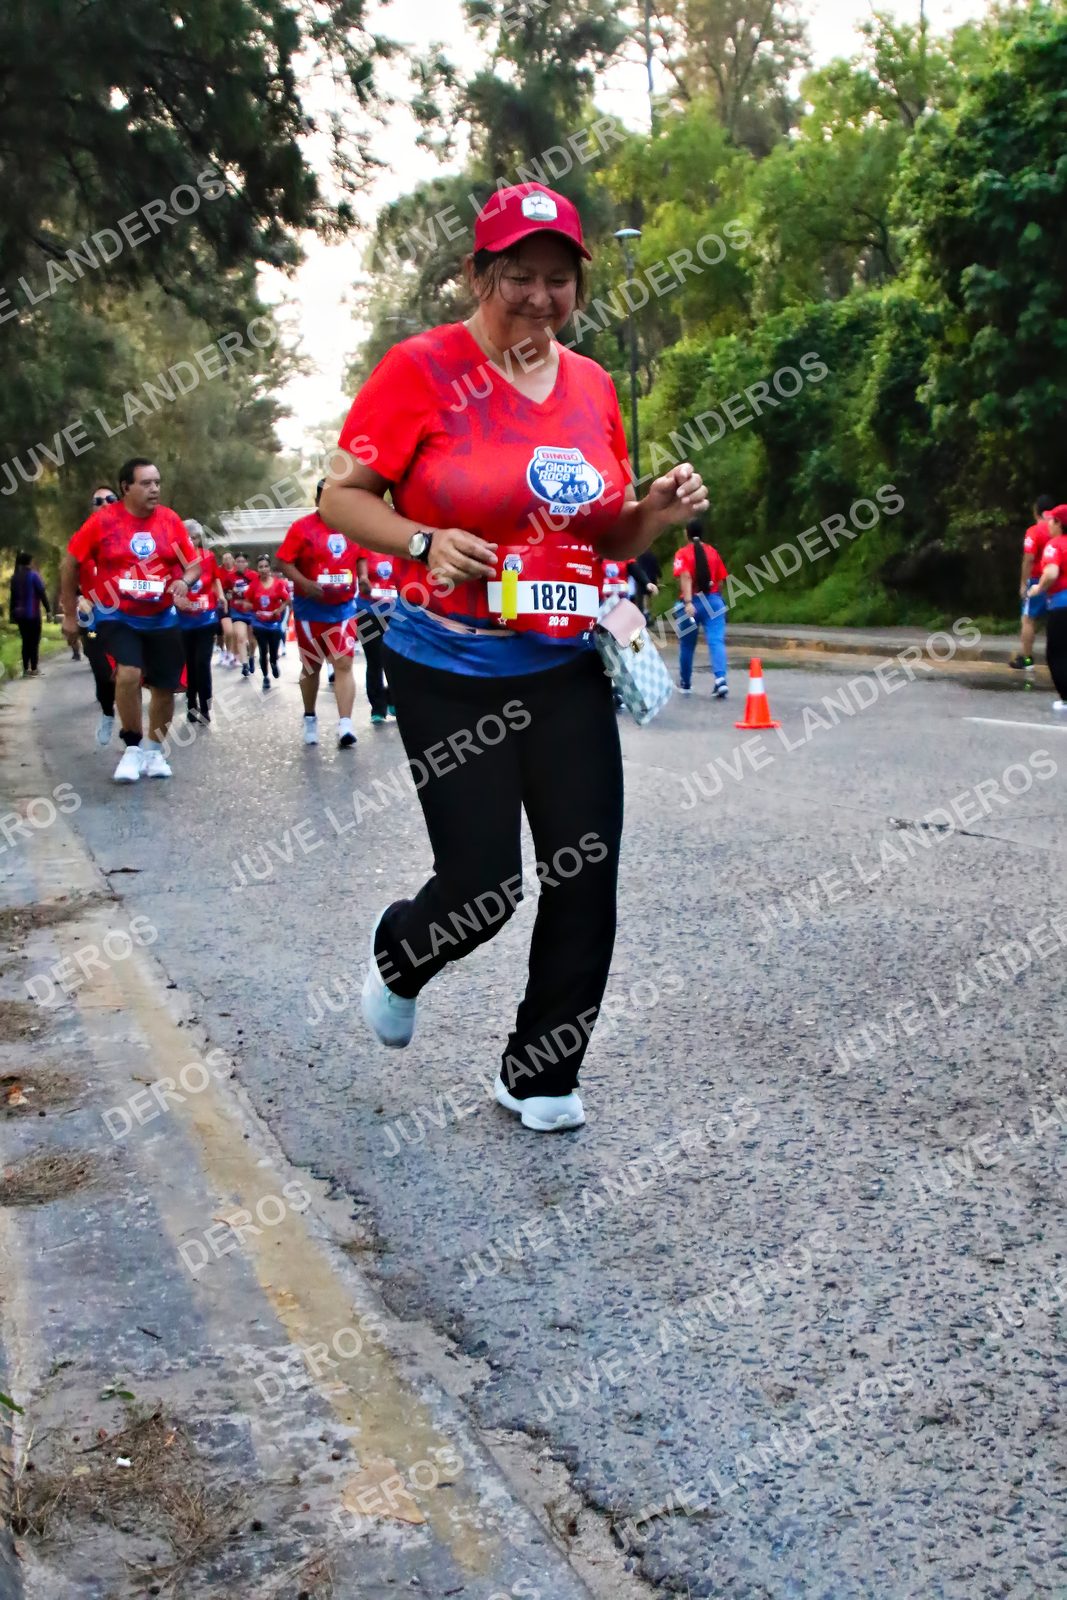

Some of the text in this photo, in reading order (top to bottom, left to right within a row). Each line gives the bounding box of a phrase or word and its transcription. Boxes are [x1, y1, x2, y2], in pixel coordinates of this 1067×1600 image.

[541, 452, 578, 461] BIMBO
[545, 462, 583, 475] Global
[538, 470, 570, 482] Race
[552, 505, 577, 515] 2026
[132, 580, 151, 590] 3581
[530, 583, 577, 612] 1829
